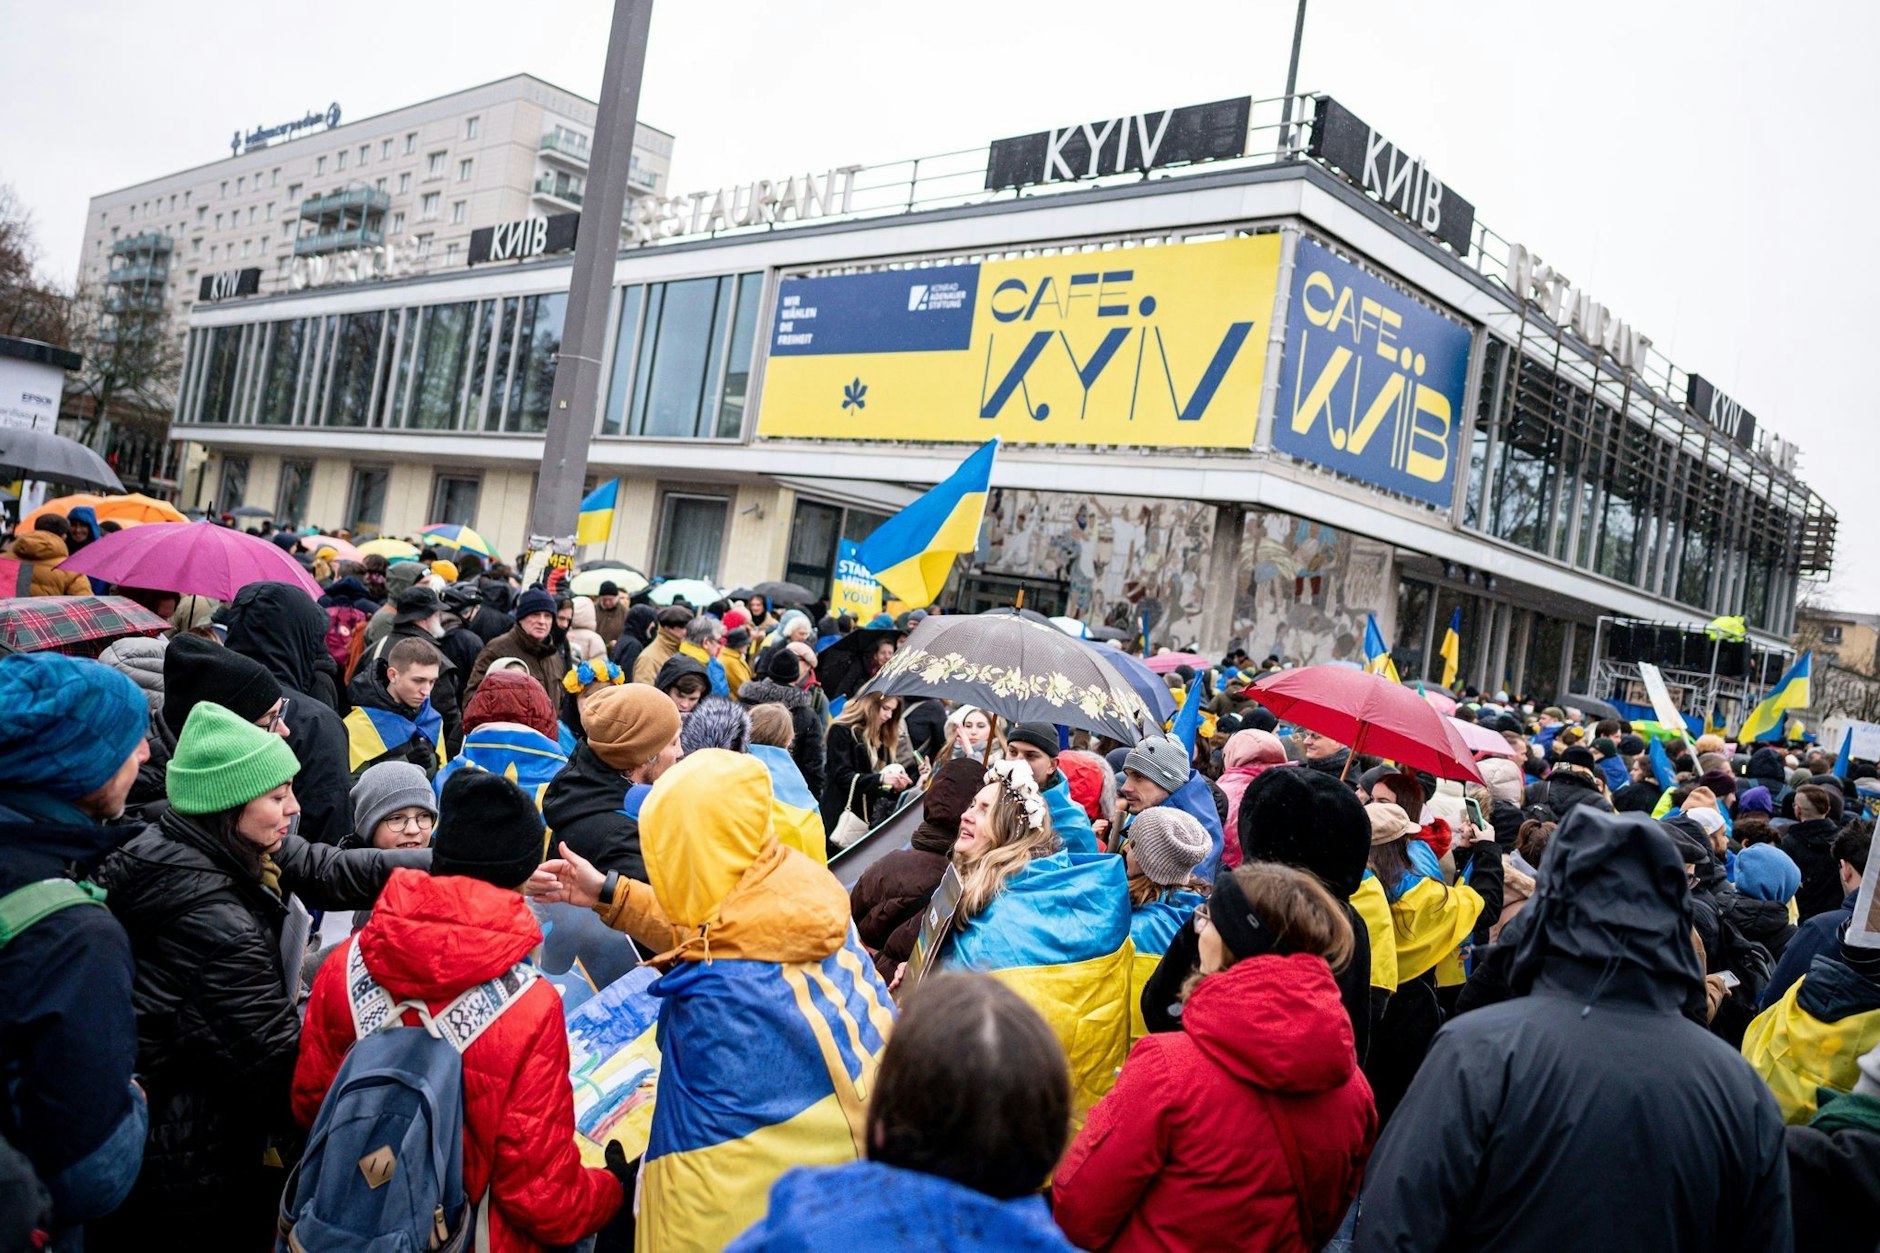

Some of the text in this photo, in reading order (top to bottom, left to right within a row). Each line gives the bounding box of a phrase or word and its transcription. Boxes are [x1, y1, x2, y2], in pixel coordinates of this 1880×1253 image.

[1043, 109, 1174, 183] KYIV
[211, 269, 242, 299] KYIV
[930, 291, 967, 300] ADENAUER
[928, 300, 962, 310] STIFTUNG
[1303, 271, 1402, 363] CAFE
[777, 333, 813, 345] FREIHEIT
[1709, 387, 1743, 438] KYIV
[842, 575, 876, 592] WITH
